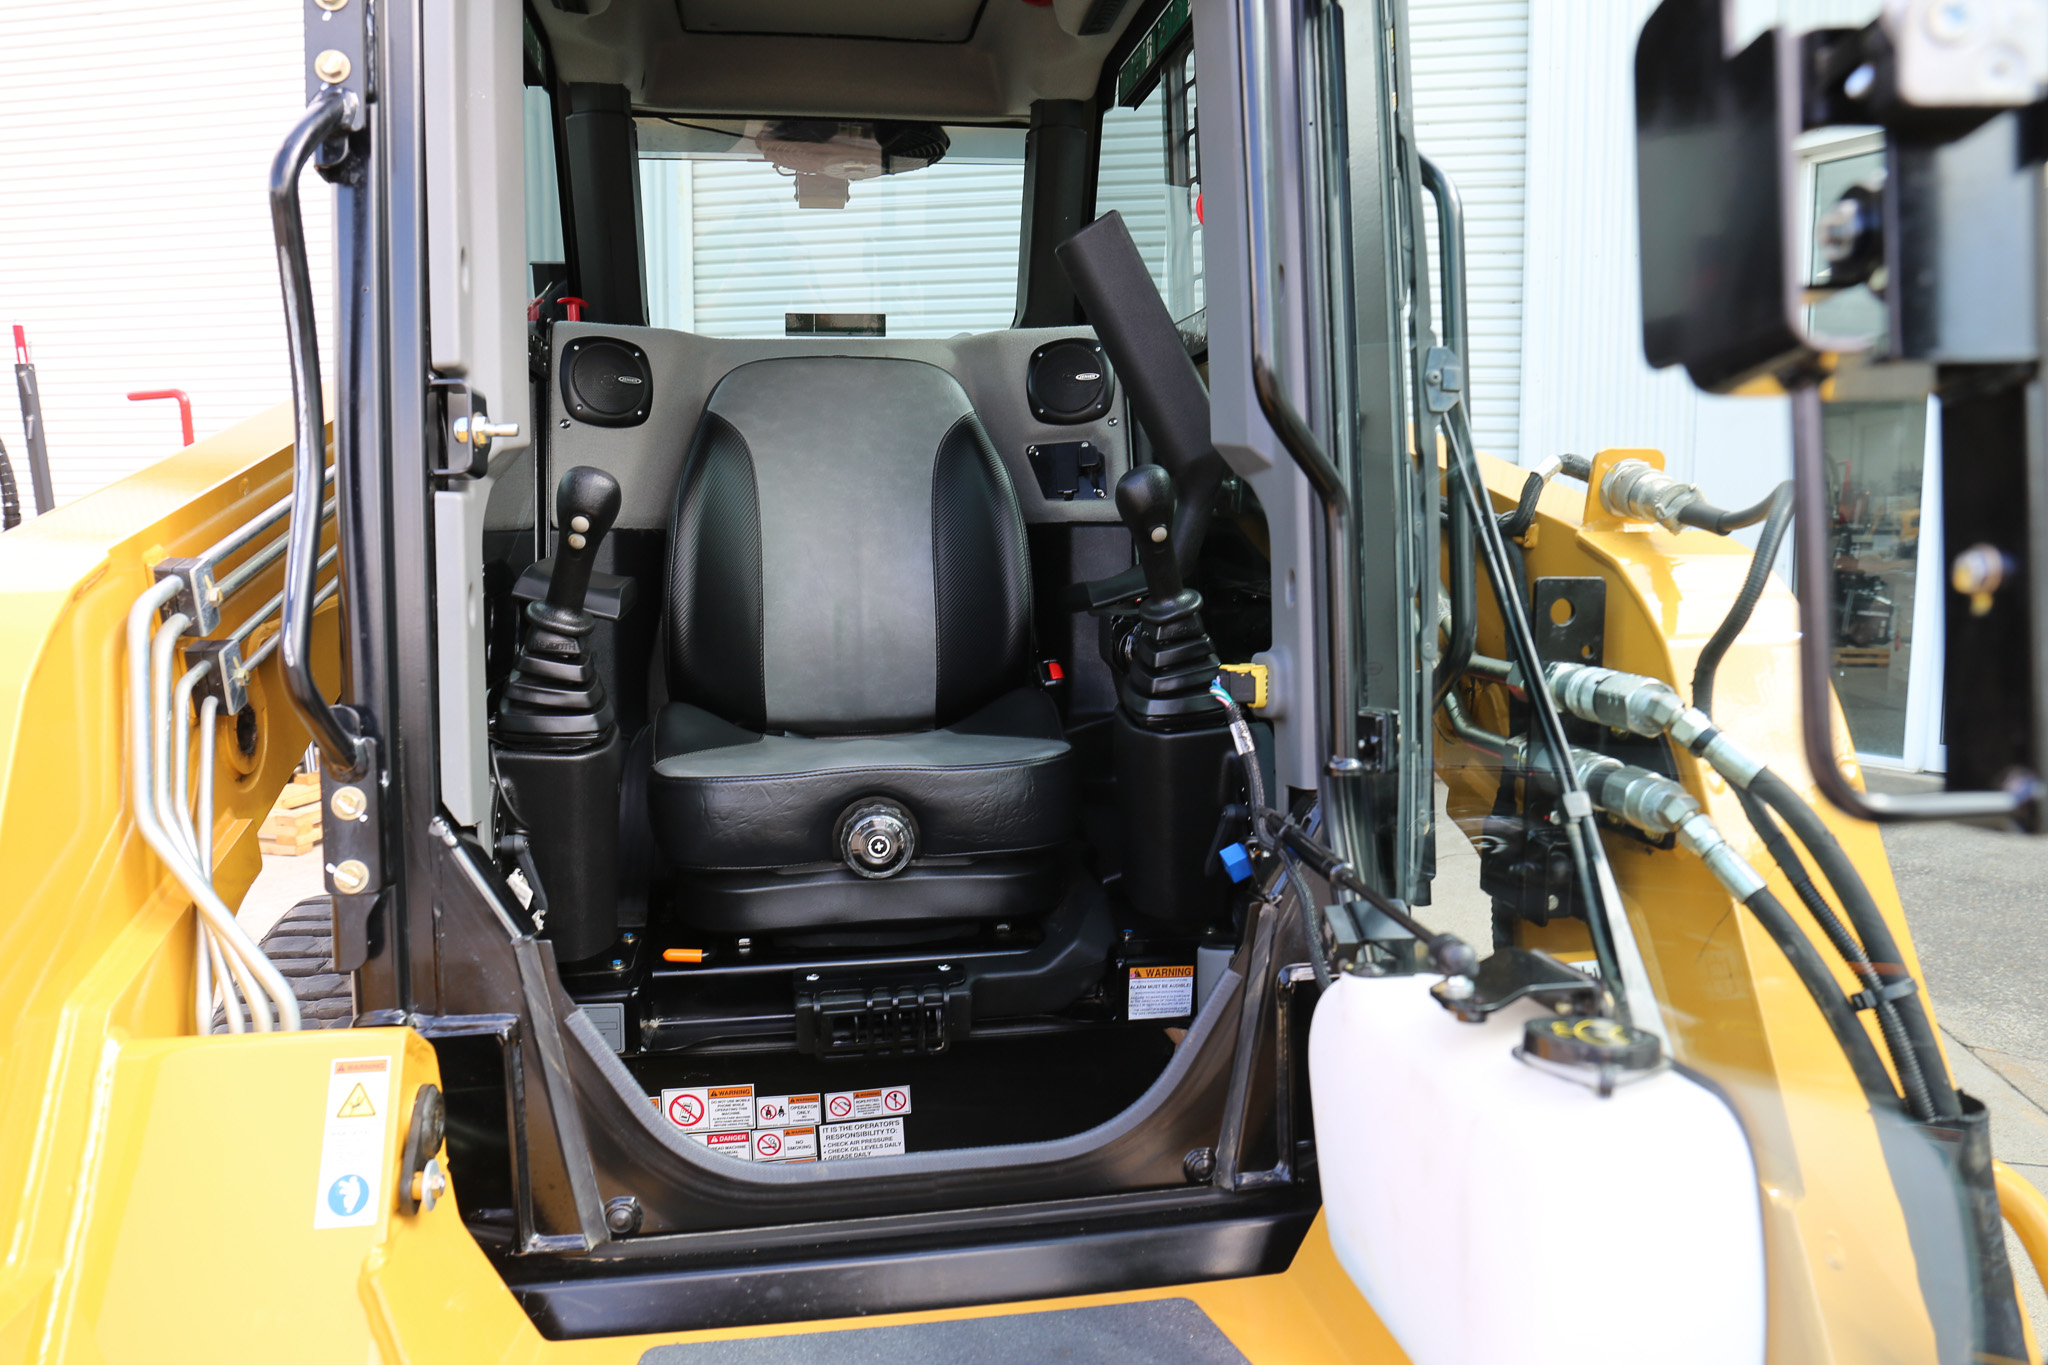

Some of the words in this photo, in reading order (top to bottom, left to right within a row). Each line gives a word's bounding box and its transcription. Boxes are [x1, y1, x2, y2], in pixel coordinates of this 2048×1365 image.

[1146, 967, 1191, 977] WARNING
[348, 1063, 385, 1071] WARNING
[718, 1088, 750, 1096] WARNING
[854, 1120, 900, 1130] OPERATOR'S
[719, 1134, 747, 1142] DANGER
[825, 1129, 885, 1141] RESPONSIBILITY
[860, 1136, 894, 1144] PRESSURE
[827, 1153, 853, 1161] GREASE
